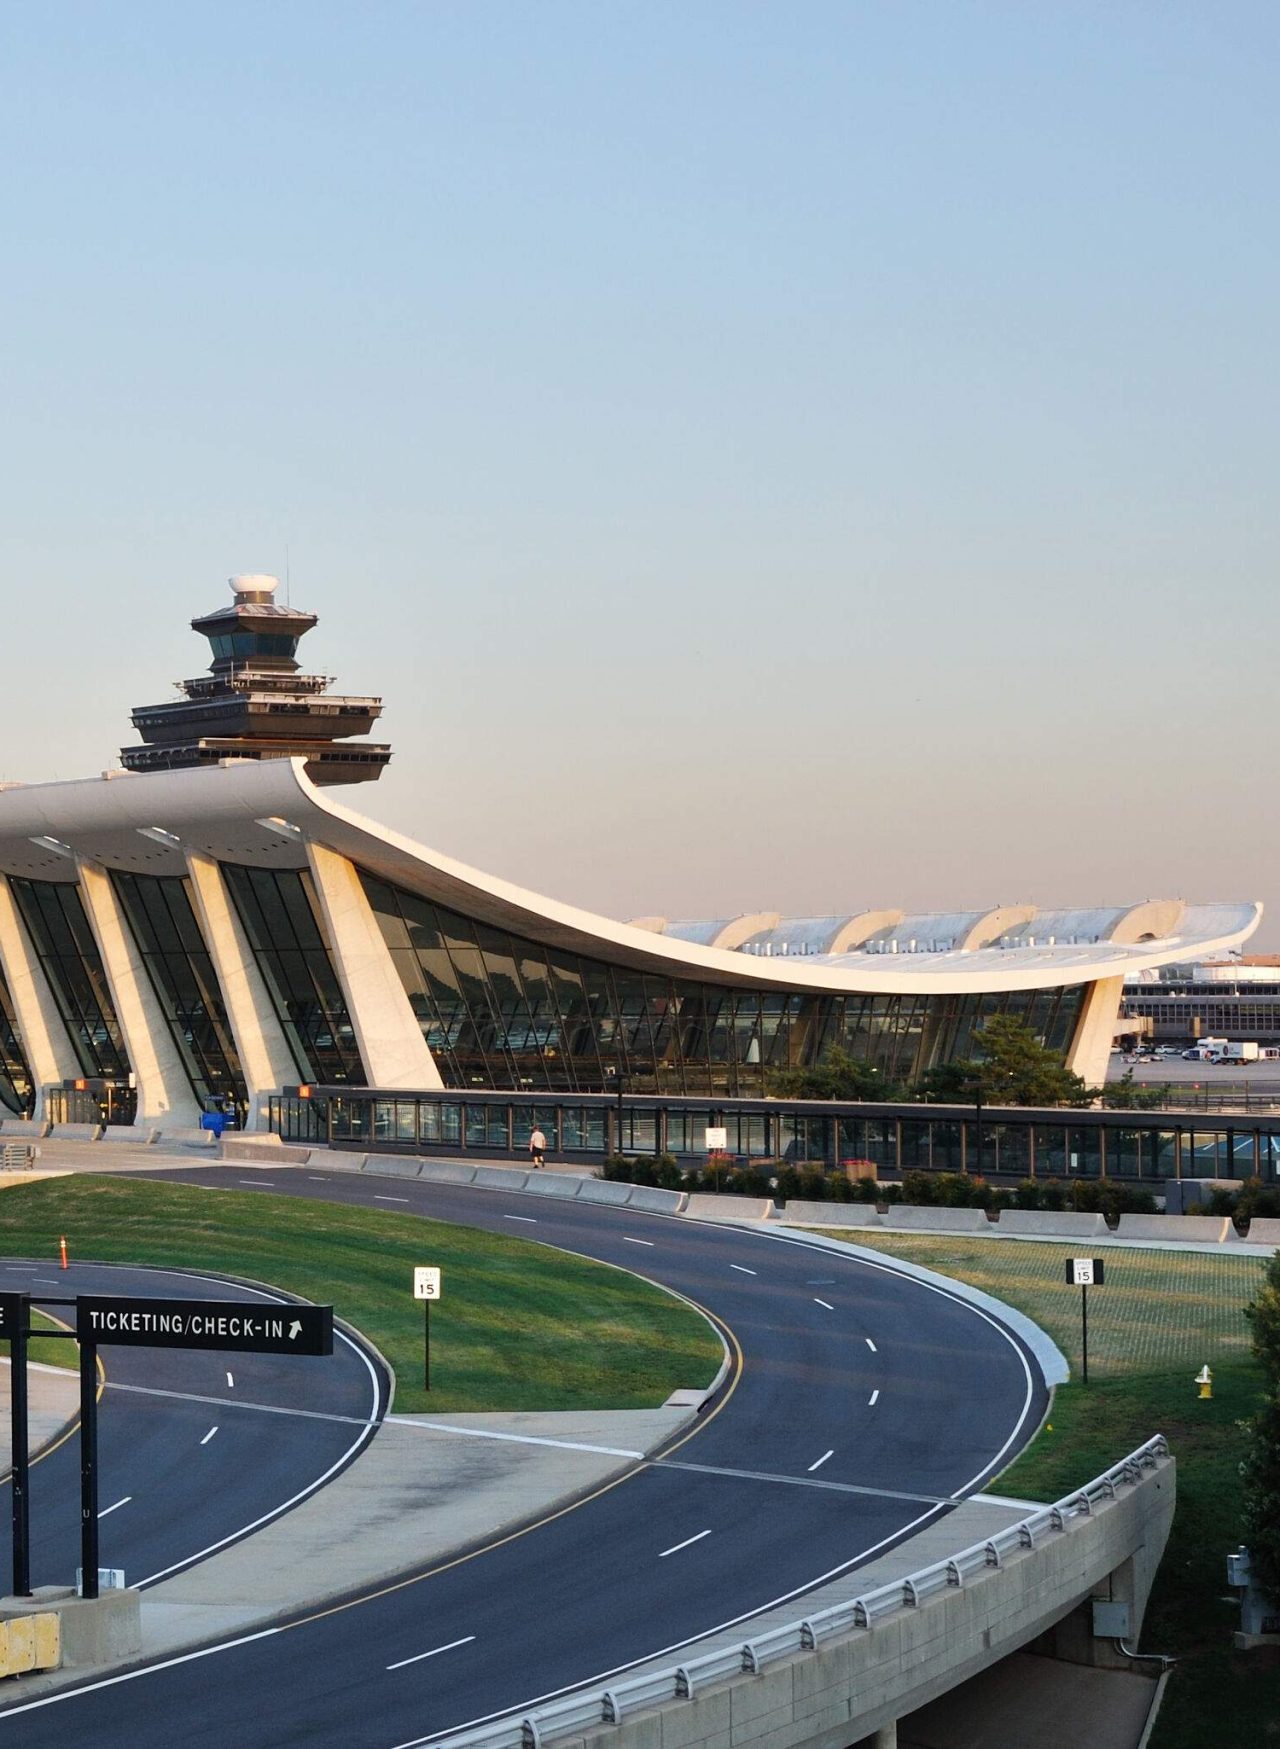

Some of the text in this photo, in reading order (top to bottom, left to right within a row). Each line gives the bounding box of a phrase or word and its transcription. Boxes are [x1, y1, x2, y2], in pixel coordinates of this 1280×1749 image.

[1077, 1271, 1090, 1281] 15
[420, 1284, 435, 1295] 15
[89, 1311, 283, 1338] TICKETING/CHECK-IN
